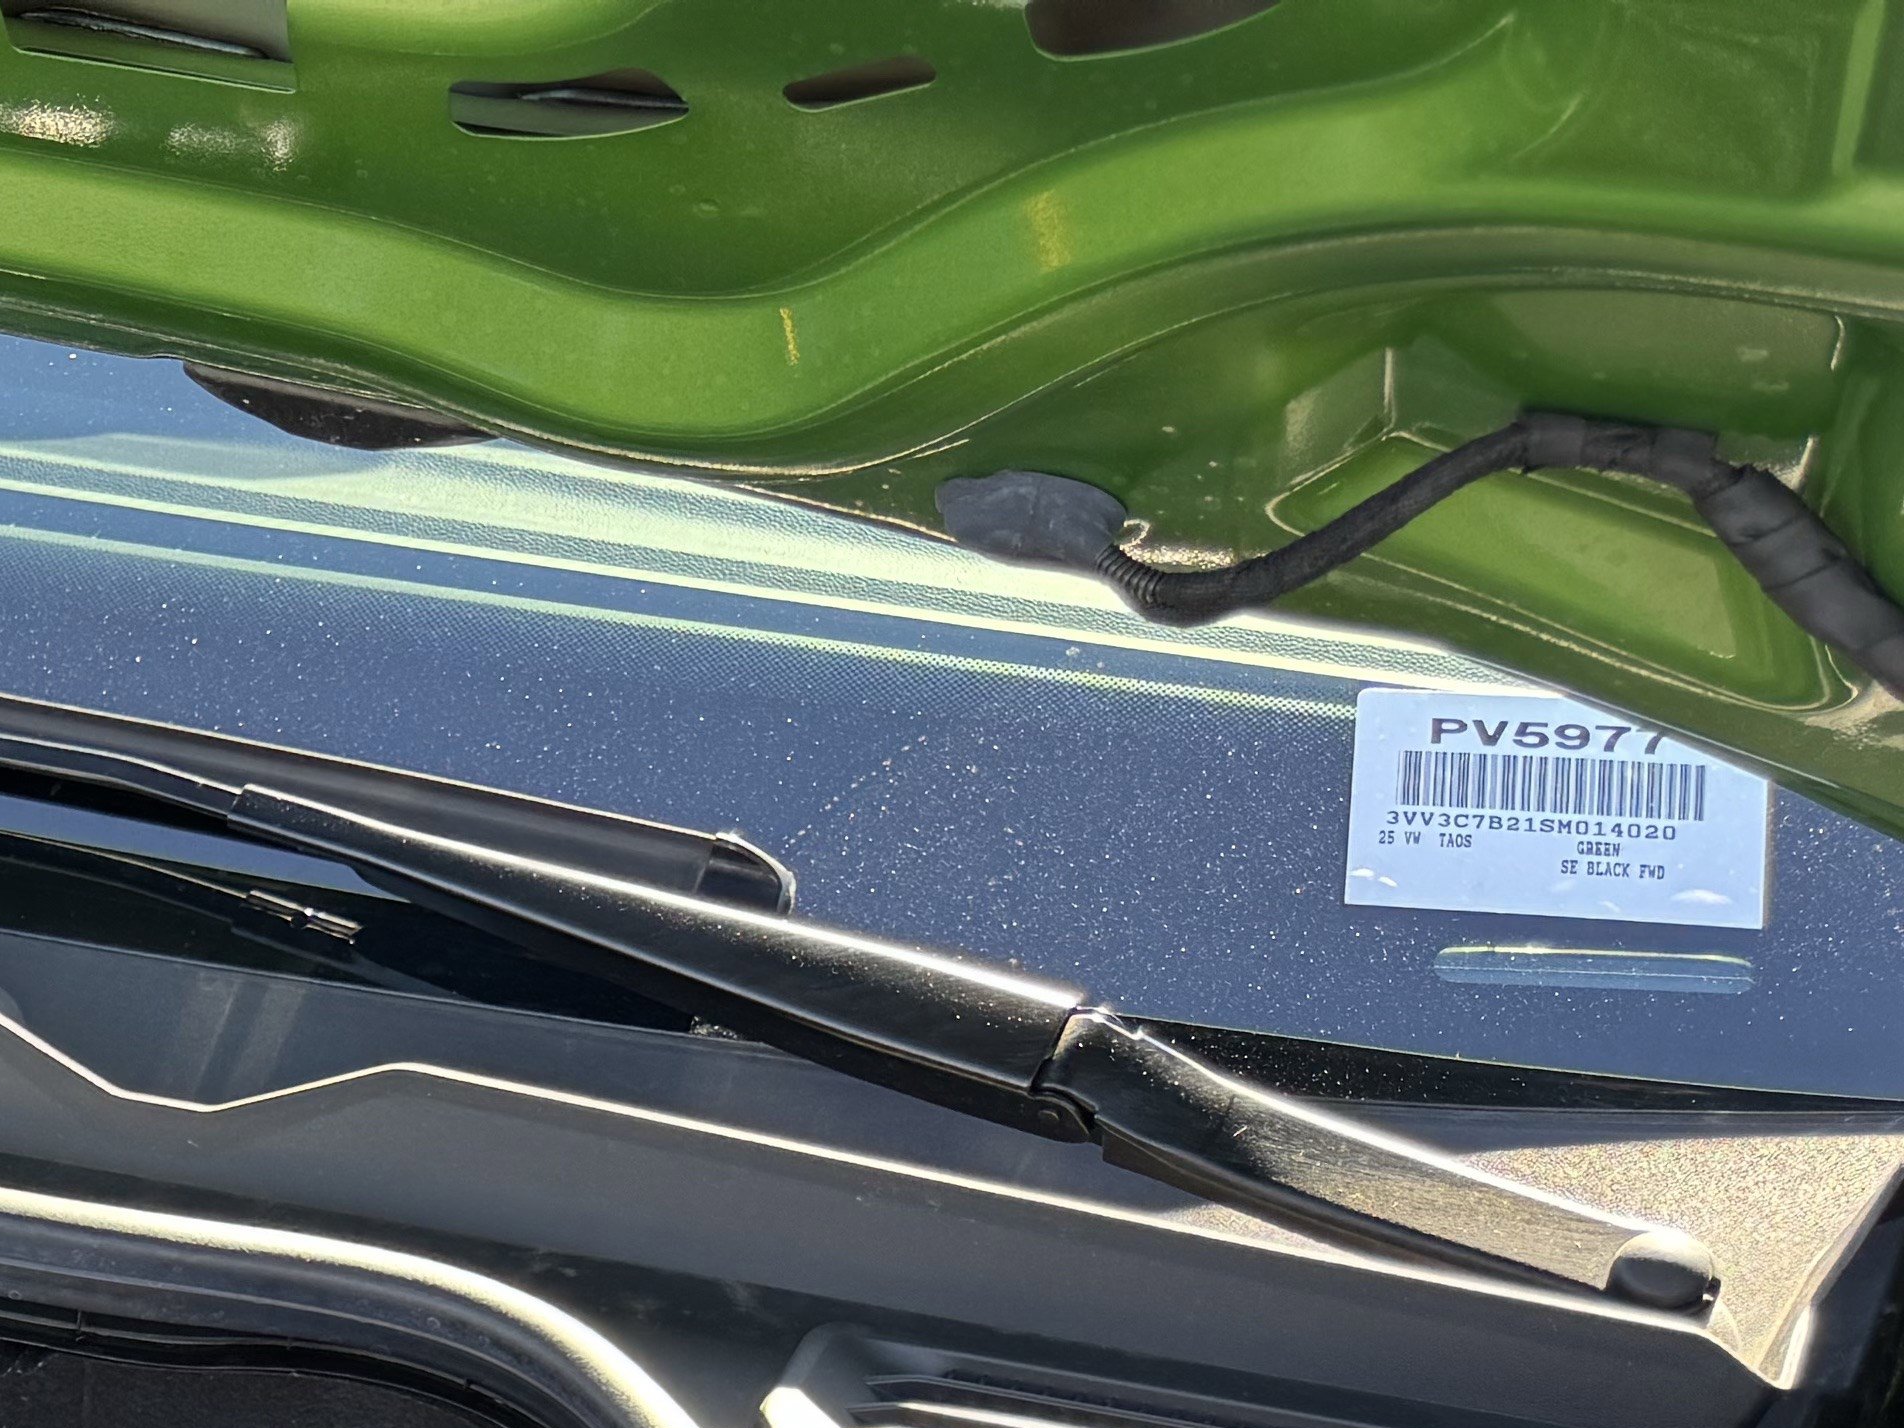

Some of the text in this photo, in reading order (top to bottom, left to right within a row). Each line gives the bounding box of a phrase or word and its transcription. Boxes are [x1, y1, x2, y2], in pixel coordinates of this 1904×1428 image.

[1386, 810, 1676, 841] 3VV3C7B21SM014020
[1378, 831, 1473, 848] 25 VW TAOS
[1577, 840, 1621, 858] GREEN
[1560, 860, 1666, 880] SE BLACK FWD
